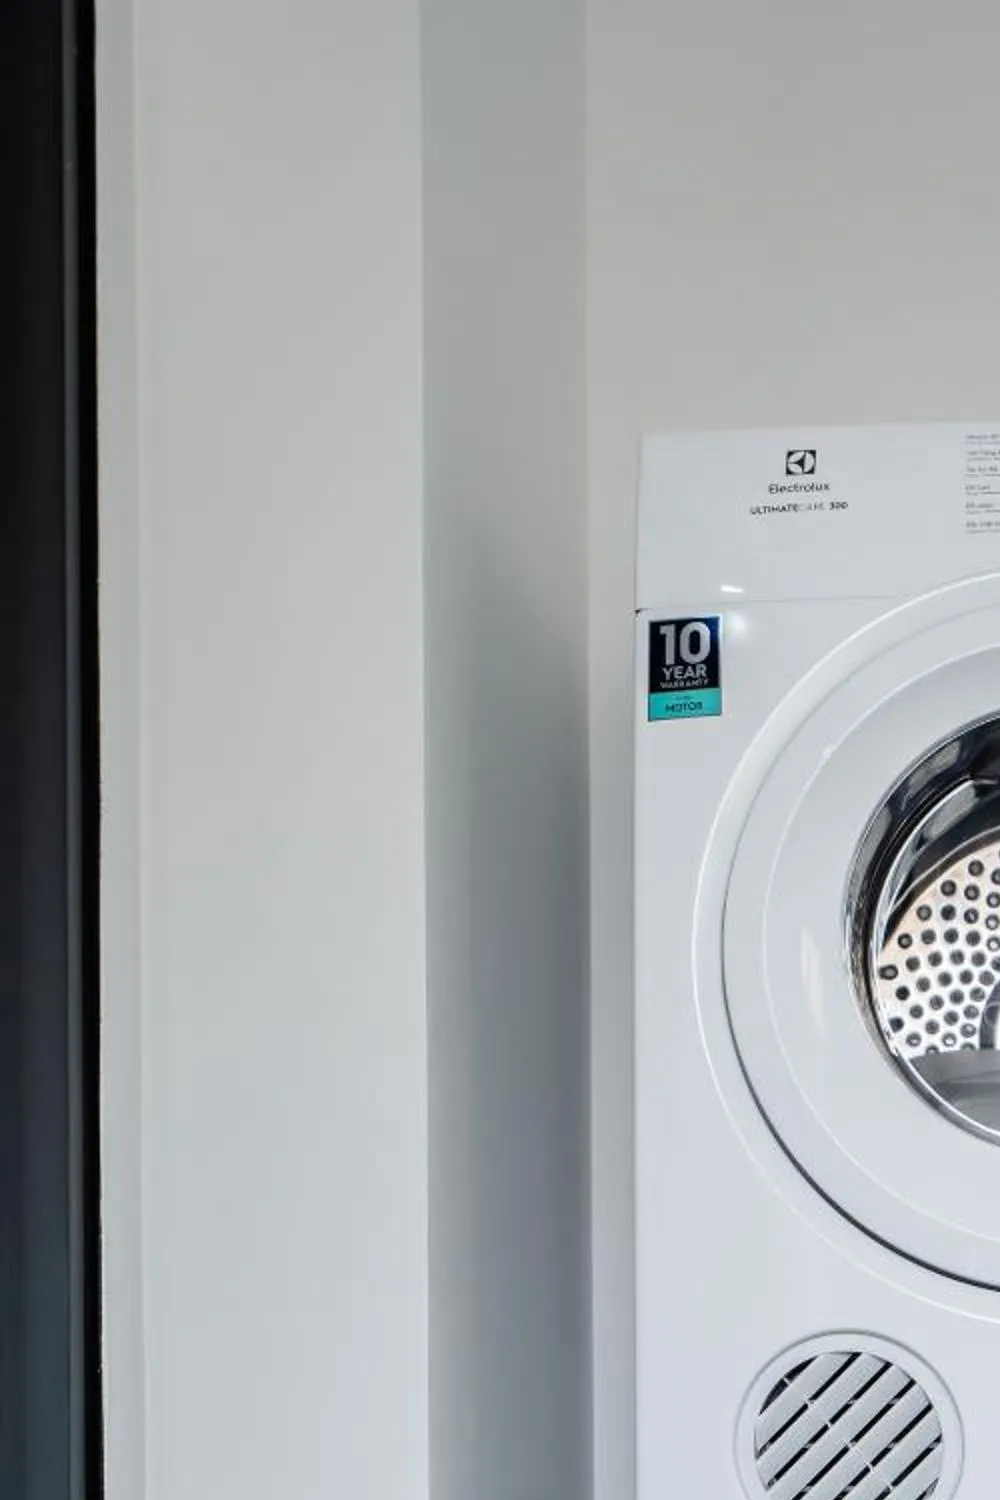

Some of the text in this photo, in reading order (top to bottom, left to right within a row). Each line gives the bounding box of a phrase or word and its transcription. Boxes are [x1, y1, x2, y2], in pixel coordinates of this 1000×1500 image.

[768, 482, 830, 494] Electrolux
[659, 621, 711, 665] 10
[662, 663, 707, 680] YEAR
